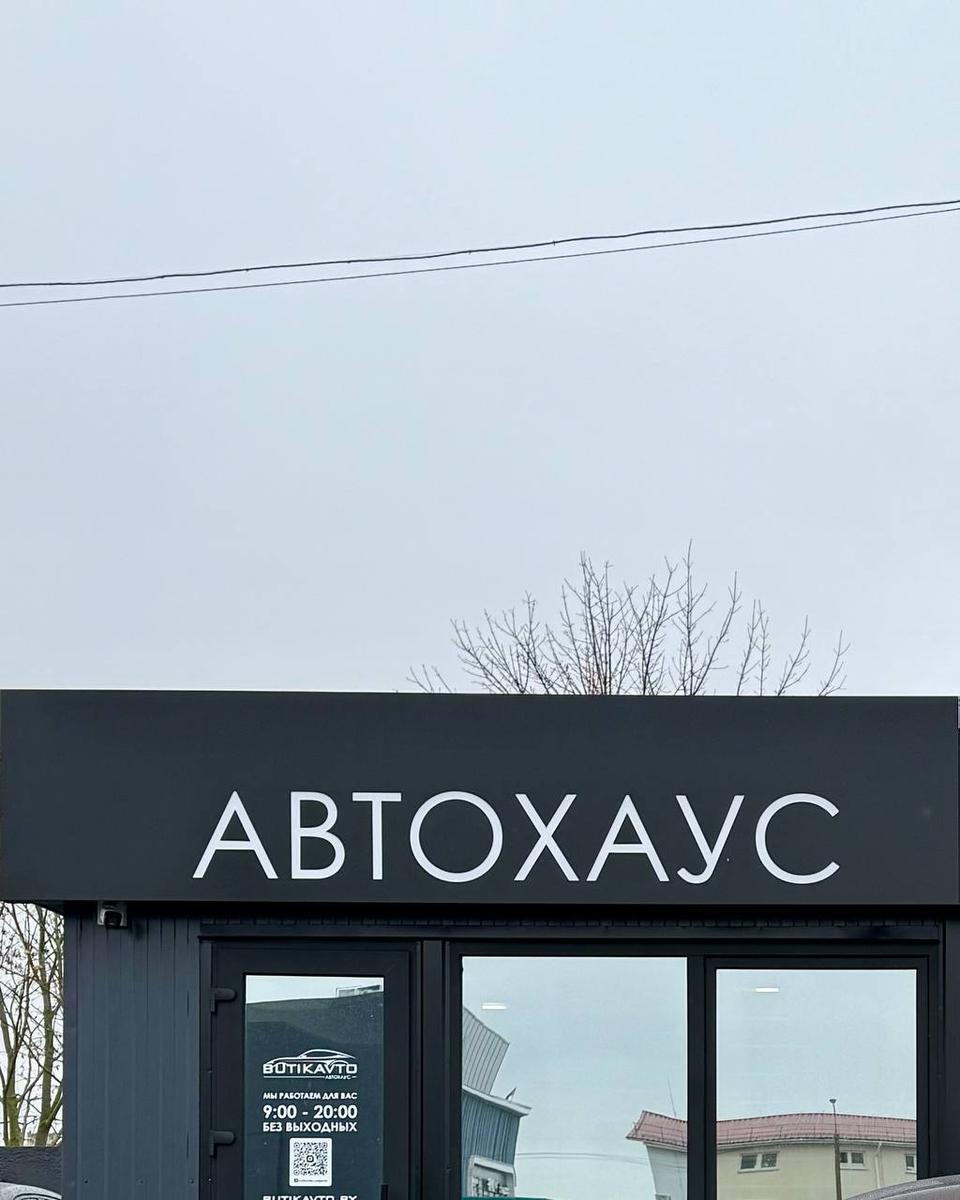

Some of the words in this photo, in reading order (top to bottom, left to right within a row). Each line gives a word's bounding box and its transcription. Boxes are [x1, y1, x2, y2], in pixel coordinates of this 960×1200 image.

[193, 791, 839, 885] АВТОХАУС
[263, 1063, 357, 1074] BUTIKAVTO
[279, 1092, 320, 1100] РАБОТАЕМ
[322, 1092, 339, 1100] ДЛЯ
[263, 1104, 297, 1119] 9:00
[313, 1104, 358, 1119] 20:00
[263, 1121, 282, 1132] БЕЗ
[286, 1121, 358, 1133] ВЫХОДНЫХ
